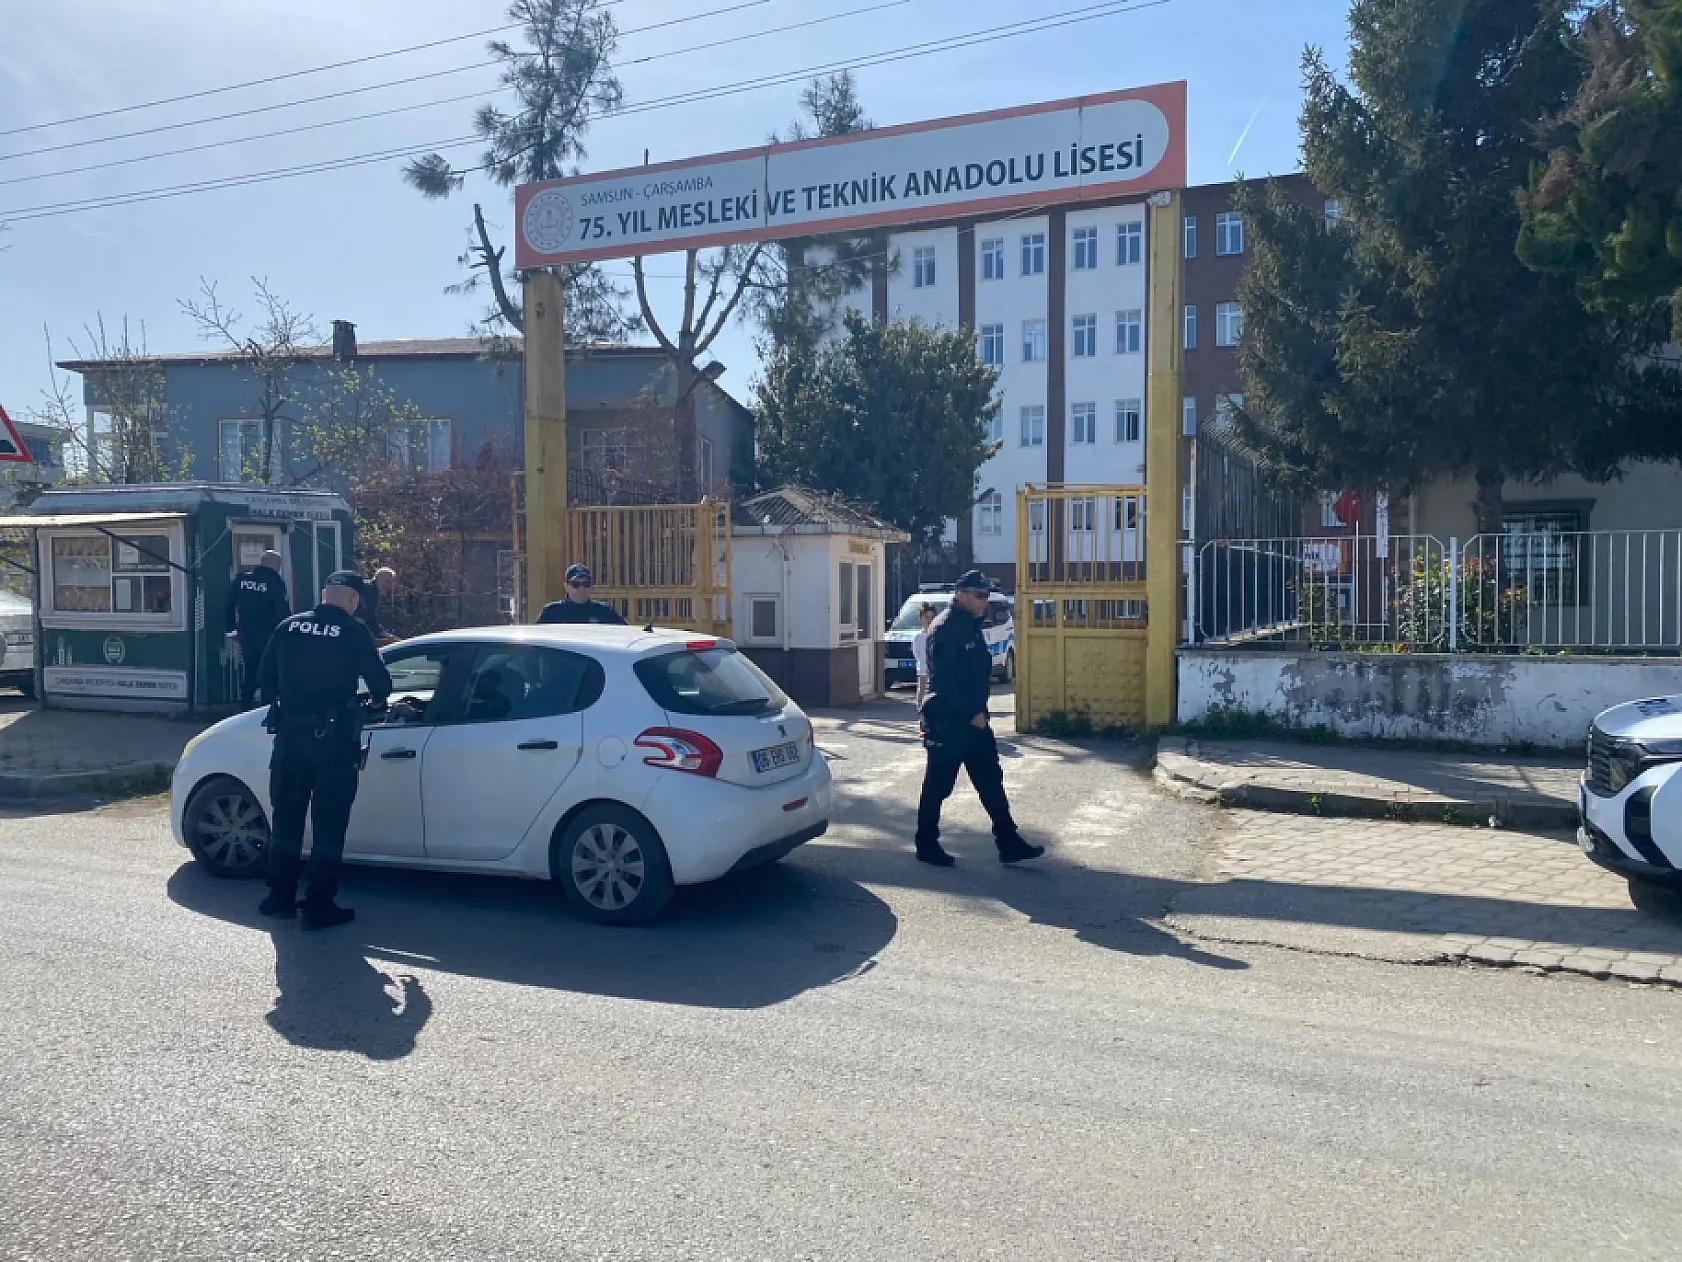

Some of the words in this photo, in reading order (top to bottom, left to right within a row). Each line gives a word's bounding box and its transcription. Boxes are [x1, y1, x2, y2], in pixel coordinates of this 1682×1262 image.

[579, 216, 612, 240] 75.
[618, 208, 652, 235] YIL
[658, 189, 757, 231] MESLEKİ
[766, 189, 796, 216] VE
[802, 172, 897, 211] TEKNİK
[904, 154, 1044, 197] ANADOLU
[1054, 133, 1144, 178] LİSESİ
[581, 189, 633, 207] SAMSUN
[643, 176, 713, 200] ÇARŞAMBA
